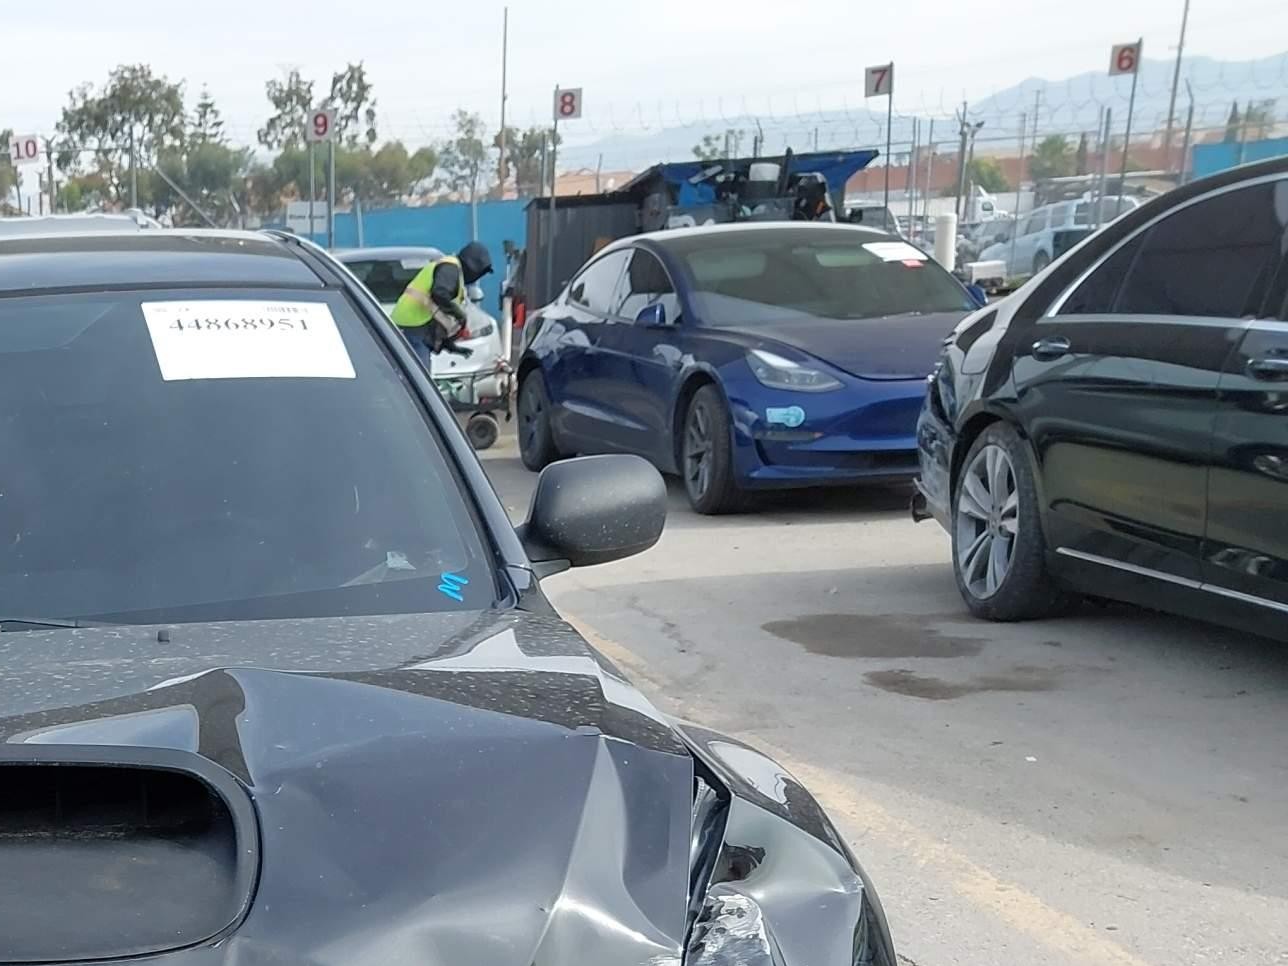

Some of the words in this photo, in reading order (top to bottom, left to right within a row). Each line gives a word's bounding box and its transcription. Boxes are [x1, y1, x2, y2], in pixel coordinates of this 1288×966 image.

[1116, 46, 1135, 72] 6
[871, 69, 888, 93] 7
[560, 92, 575, 116] 8
[313, 113, 328, 136] 9
[13, 139, 37, 160] 10
